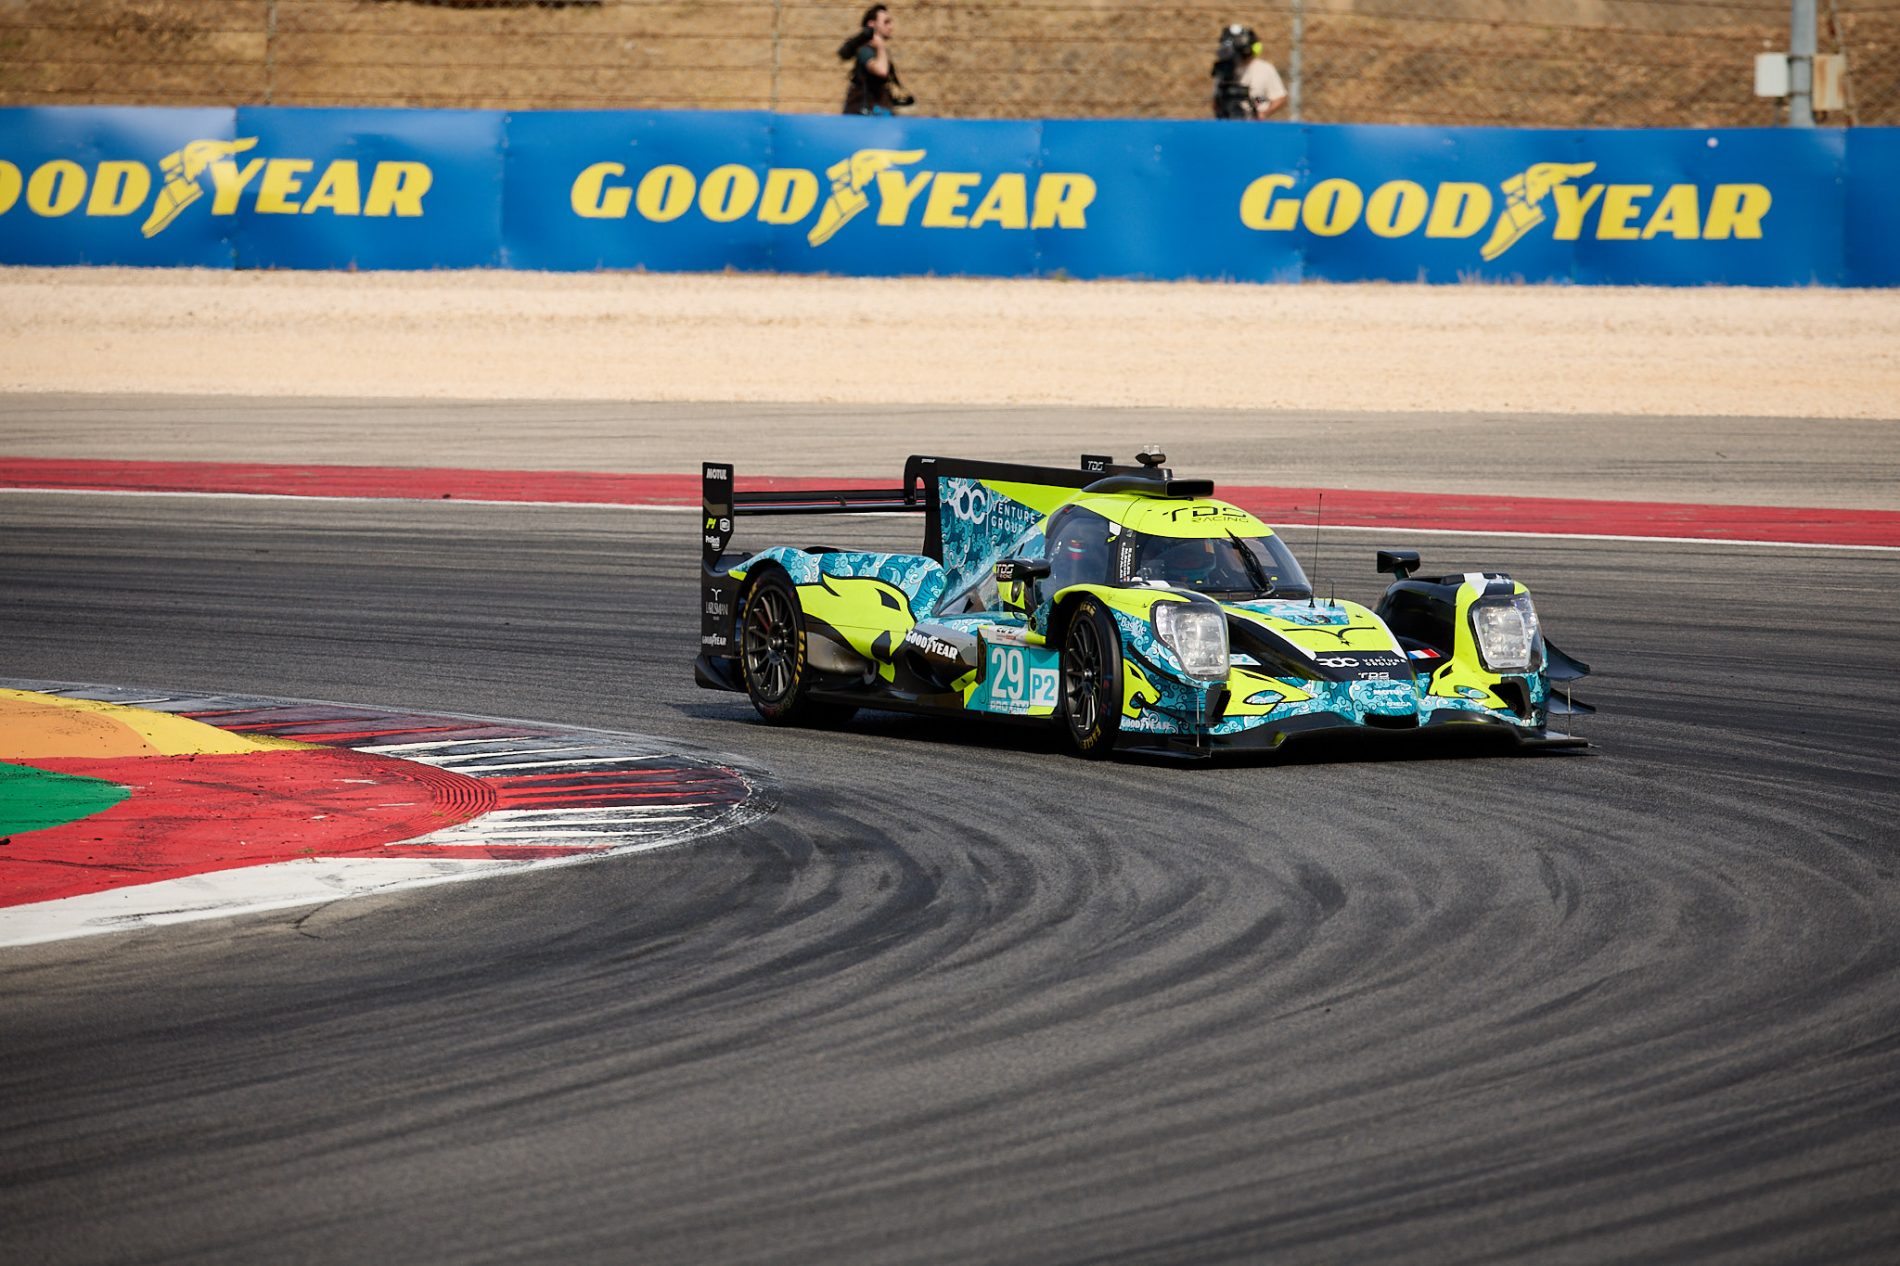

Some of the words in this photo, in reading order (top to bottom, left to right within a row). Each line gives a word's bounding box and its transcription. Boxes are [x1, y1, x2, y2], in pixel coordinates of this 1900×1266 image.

[570, 160, 1097, 230] GOODYEAR
[1239, 172, 1773, 241] GOODYEAR
[706, 468, 727, 480] MOTUL
[1087, 460, 1104, 471] TDS
[991, 501, 1036, 525] VENTURE
[991, 516, 1025, 534] GROUP
[905, 631, 959, 660] GOODYEAR
[991, 647, 1025, 700] 29
[1031, 673, 1056, 700] P2
